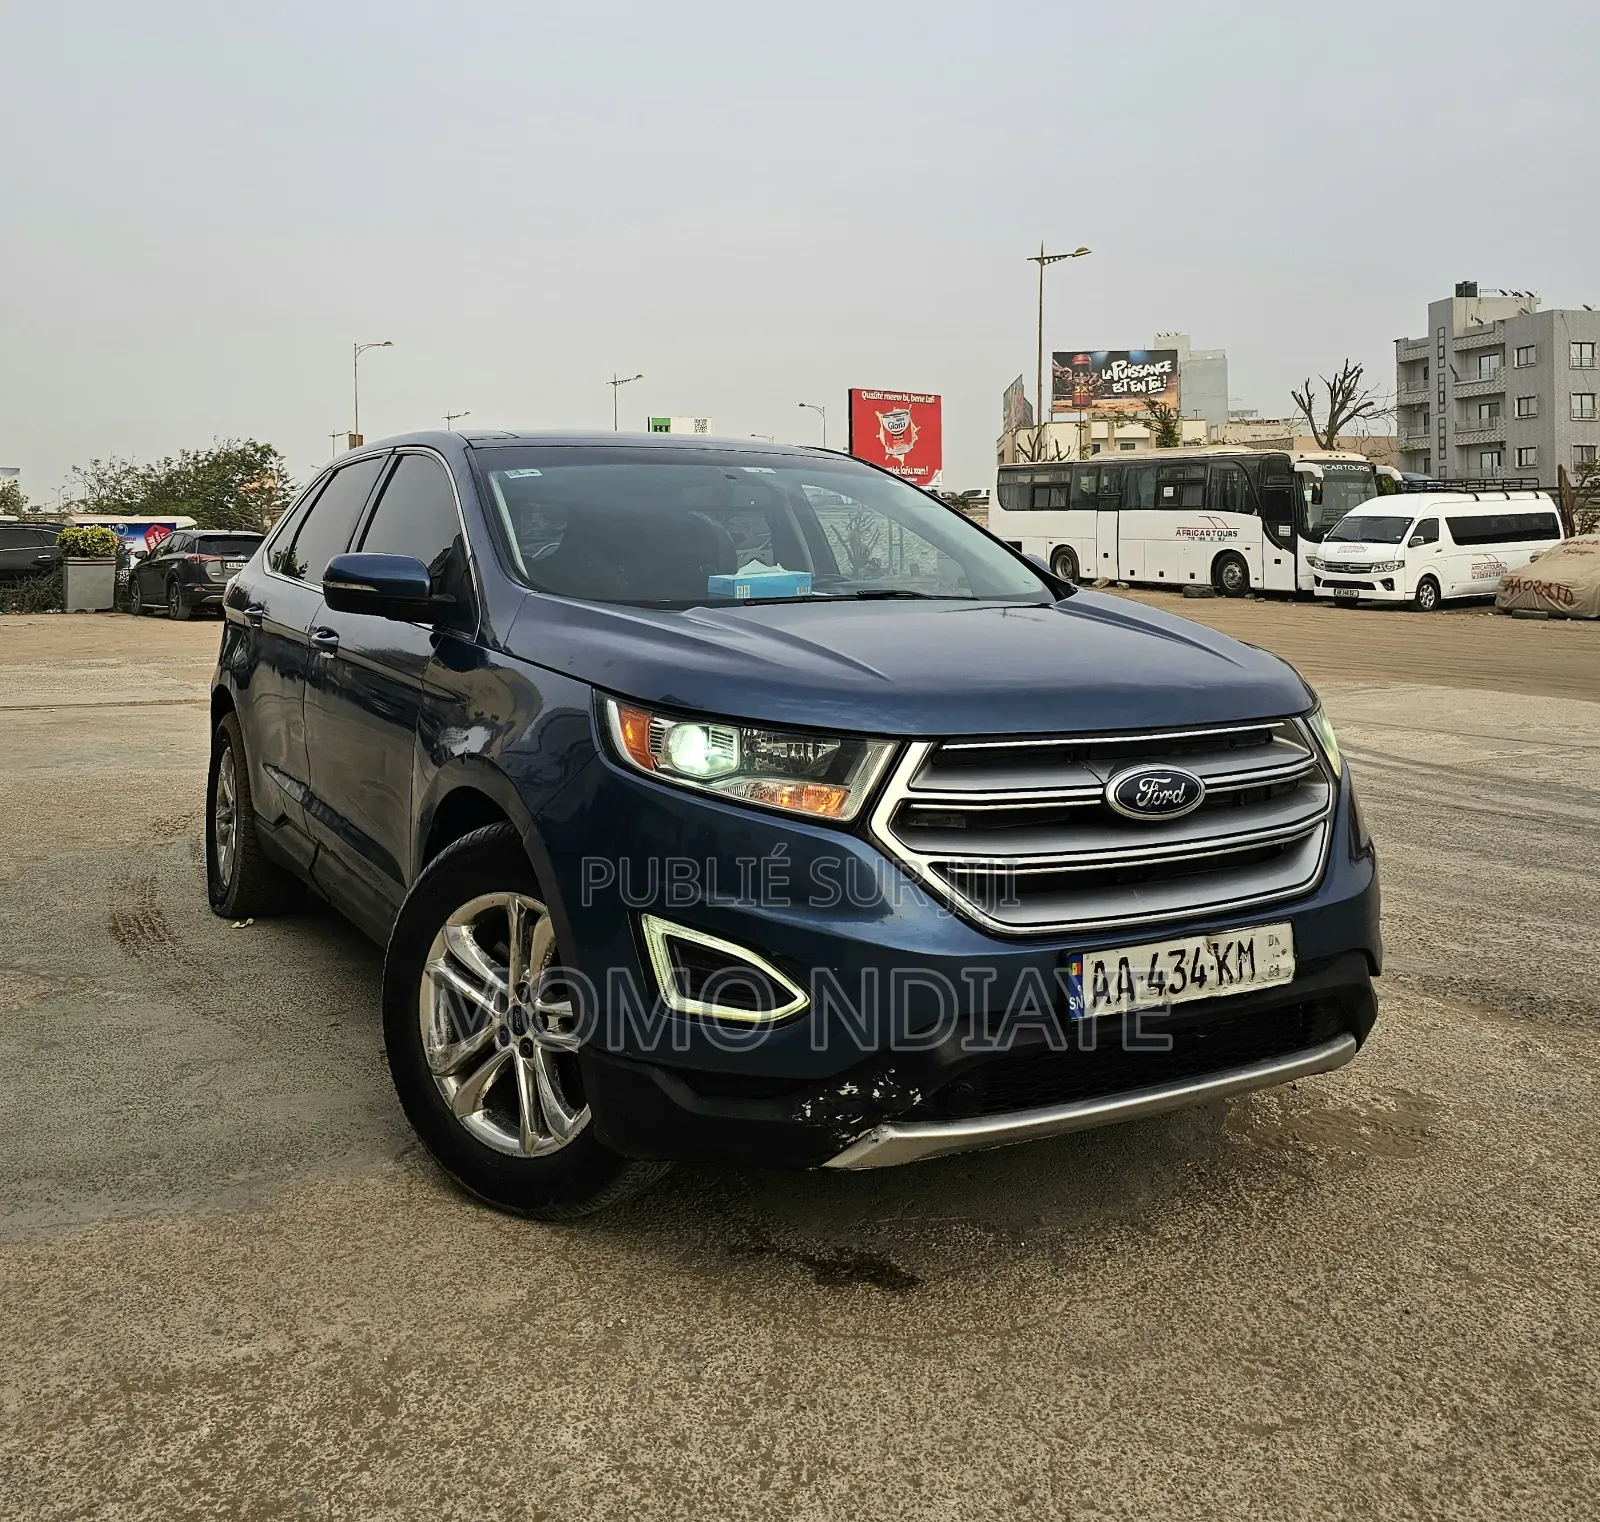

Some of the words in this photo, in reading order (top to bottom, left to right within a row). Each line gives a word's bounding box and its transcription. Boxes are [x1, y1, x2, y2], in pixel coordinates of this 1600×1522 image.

[1130, 382, 1146, 393] EN
[861, 391, 883, 400] Qualité
[888, 421, 905, 430] Gloria
[1136, 777, 1186, 808] Ford
[1069, 995, 1084, 1010] SN
